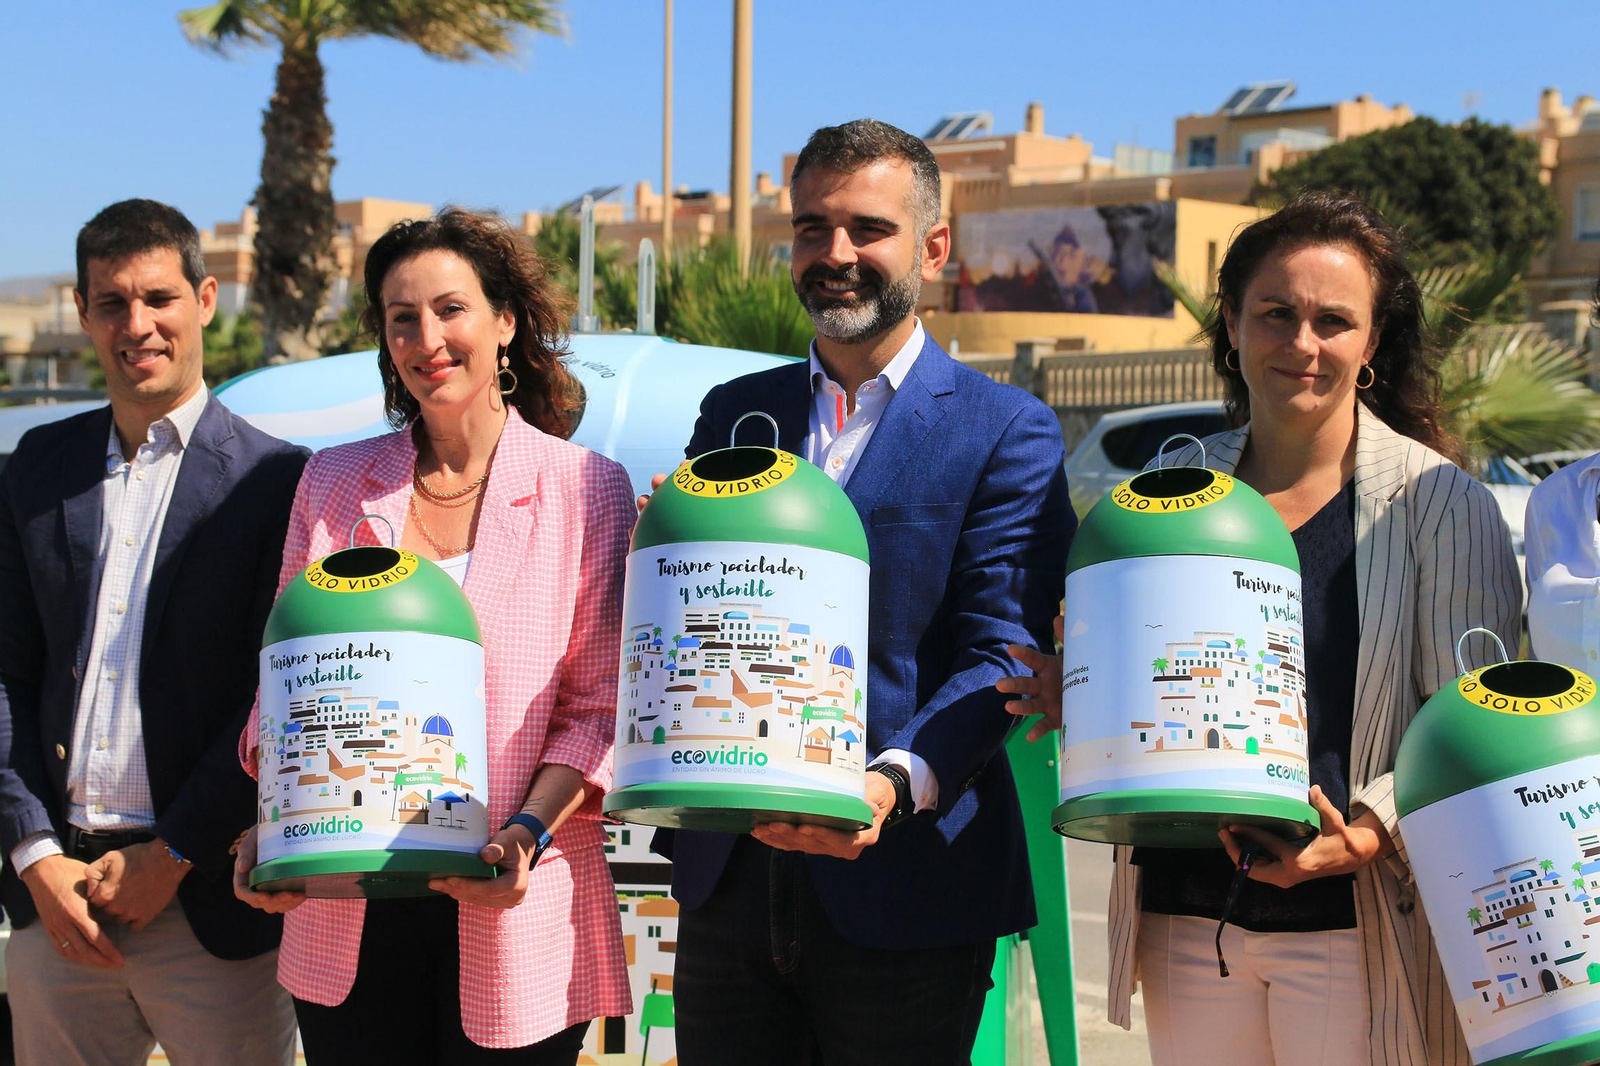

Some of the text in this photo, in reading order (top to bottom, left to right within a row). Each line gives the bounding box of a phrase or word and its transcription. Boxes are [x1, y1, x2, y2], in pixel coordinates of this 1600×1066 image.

[676, 468, 705, 492] SOLO
[715, 470, 782, 494] VIDRIO
[1114, 485, 1224, 510] SOLO VIDRIO
[307, 567, 339, 589] SOLO
[348, 566, 408, 589] VIDRIO
[657, 555, 807, 580] Turismo reciclador
[679, 578, 776, 605] y sostenible
[1232, 570, 1283, 594] Turismo
[1260, 604, 1270, 622] y
[269, 642, 394, 672] Turismo reciclador
[284, 664, 364, 694] y sostenible
[1479, 693, 1541, 713] SOLO
[1550, 675, 1593, 709] VIDRIO
[671, 745, 768, 766] ecovidrio
[1513, 779, 1589, 807] Turismo
[283, 815, 363, 838] ecovidrio
[1559, 811, 1576, 829] y
